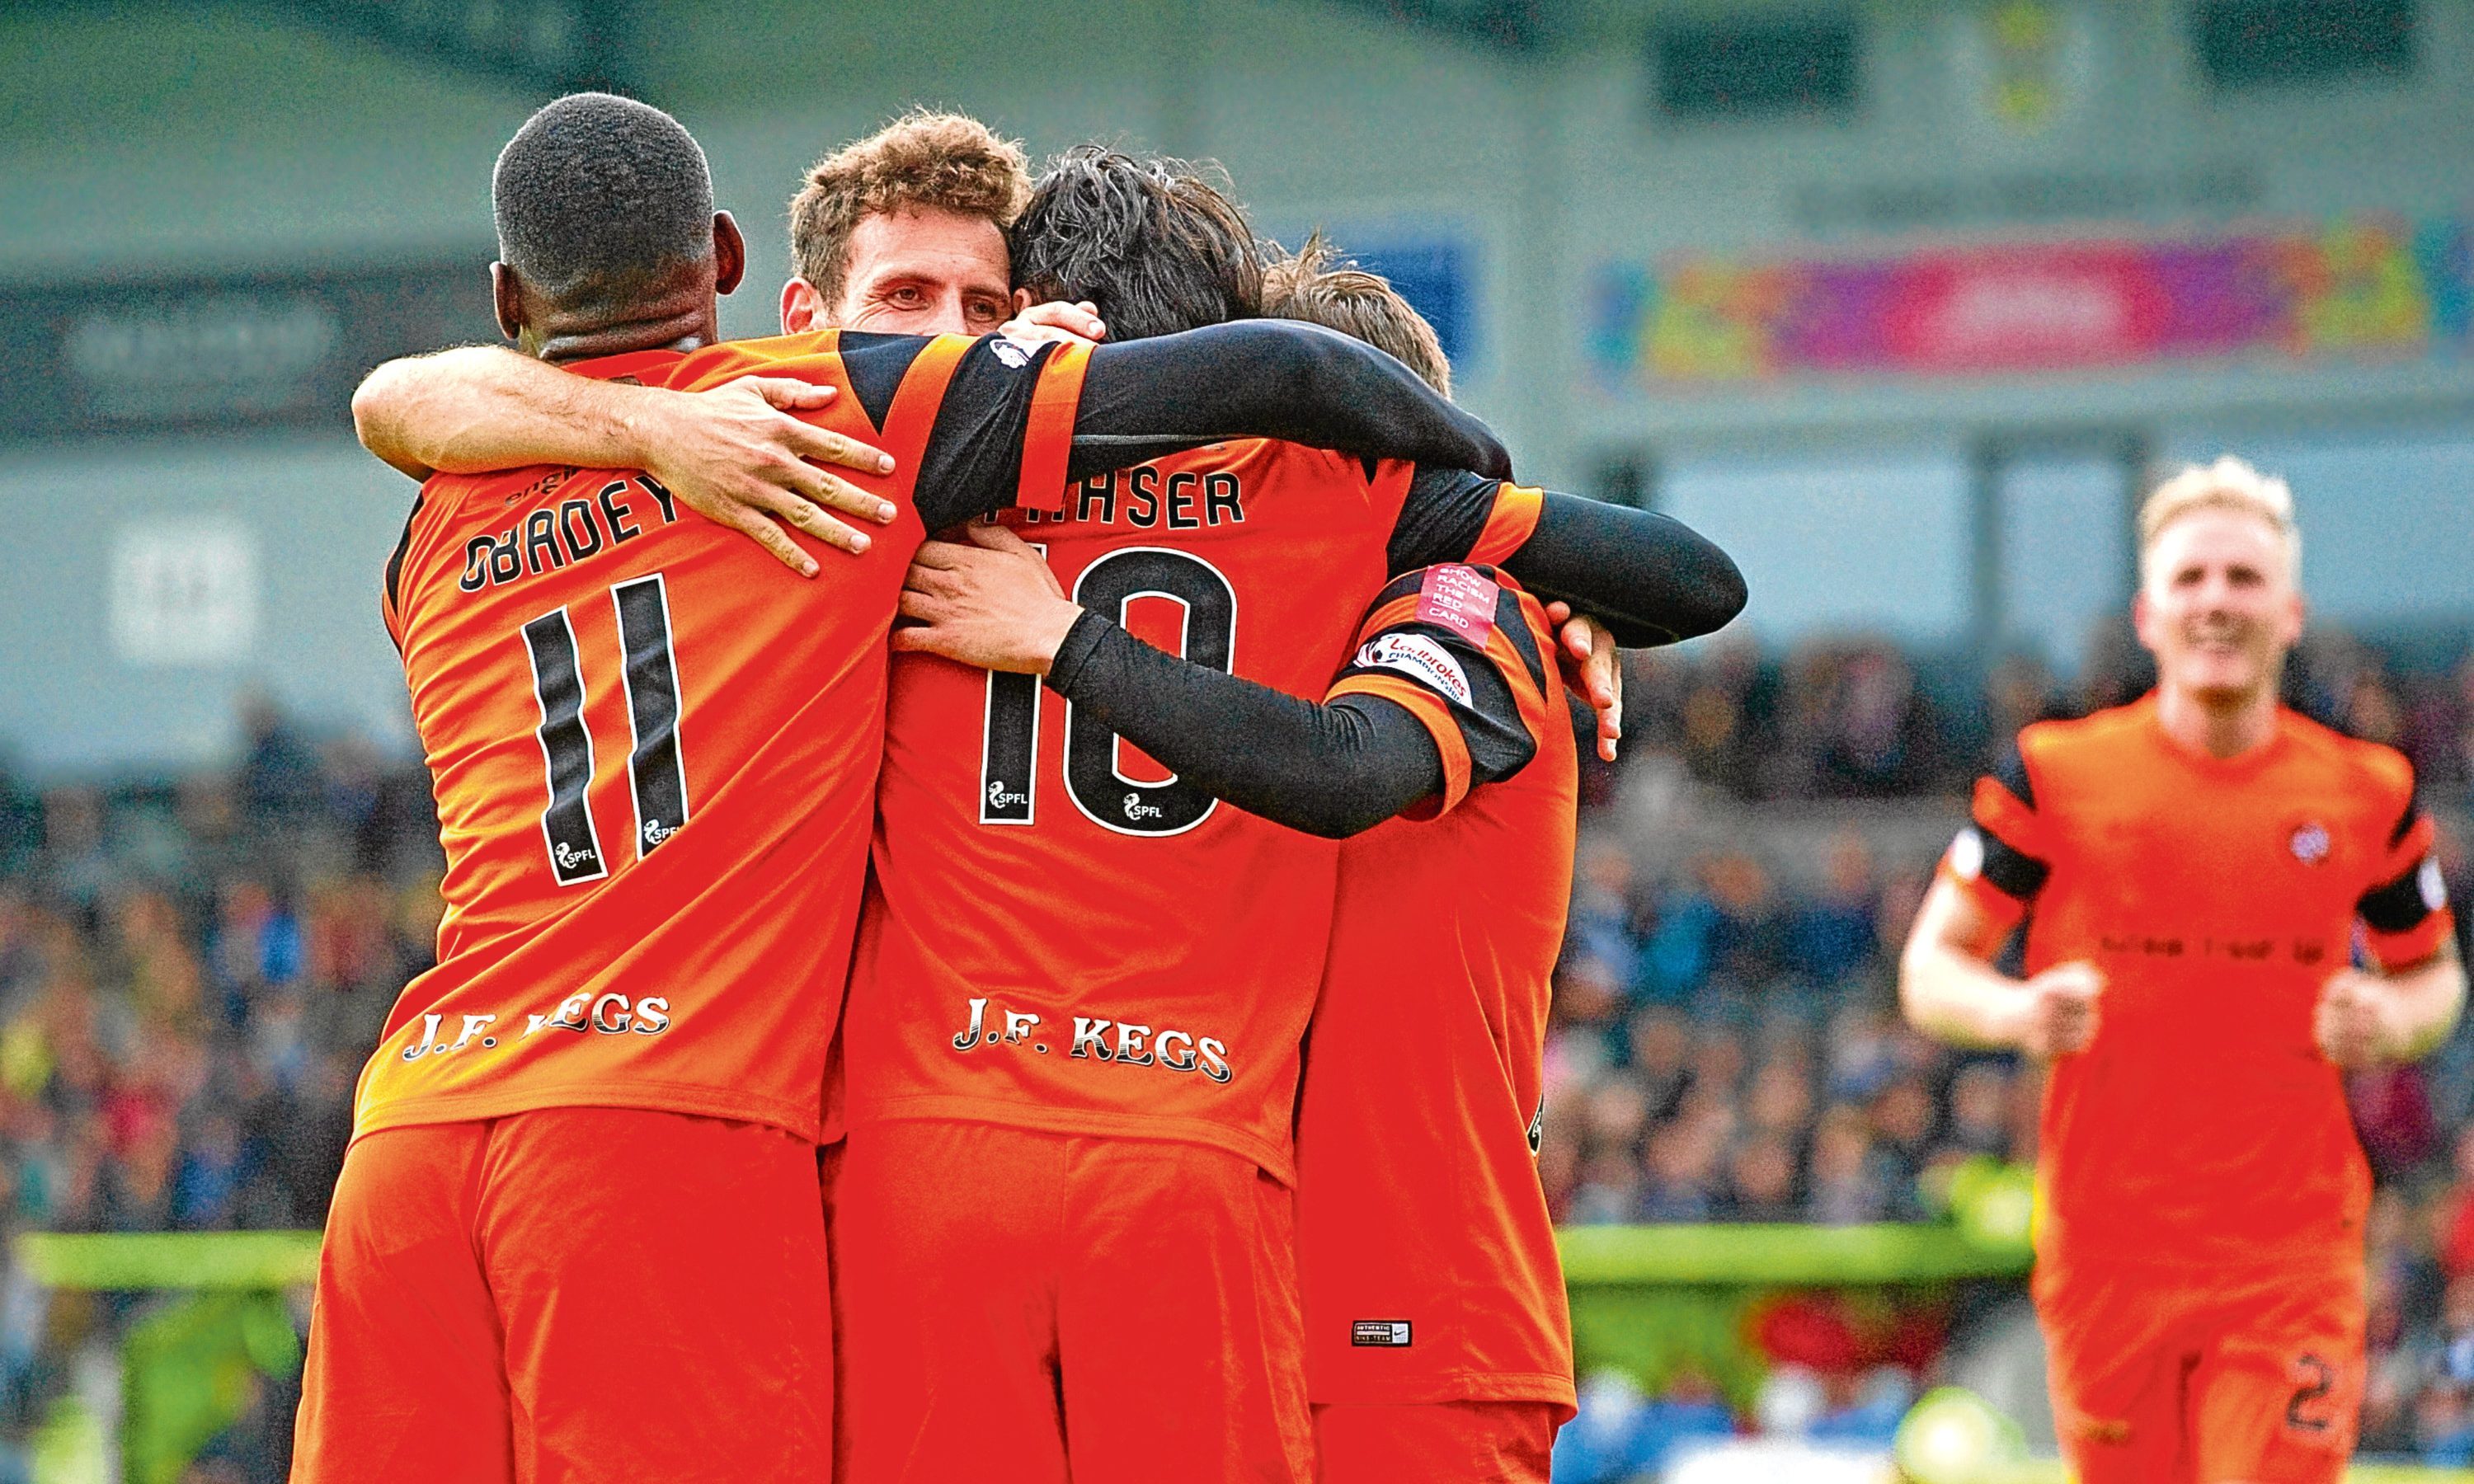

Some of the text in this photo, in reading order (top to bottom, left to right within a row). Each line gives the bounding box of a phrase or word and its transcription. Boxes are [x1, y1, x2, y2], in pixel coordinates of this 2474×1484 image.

[984, 466, 1244, 529] ASER
[459, 475, 677, 592] OBADEY
[1437, 575, 1490, 603] RACISM
[1439, 568, 1481, 587] SHOW
[1432, 593, 1462, 609] RED
[1437, 584, 1465, 599] THE
[1429, 608, 1469, 628] CARD
[980, 543, 1238, 837] 10
[520, 572, 691, 886] 11
[999, 792, 1028, 805] SPFL
[1134, 805, 1163, 818] SPFL
[654, 827, 680, 839] SPF
[567, 849, 595, 864] SPFL
[402, 1012, 498, 1062] J.F.
[952, 998, 1232, 1083] J.F. KEGS
[2287, 1353, 2332, 1430] 2
